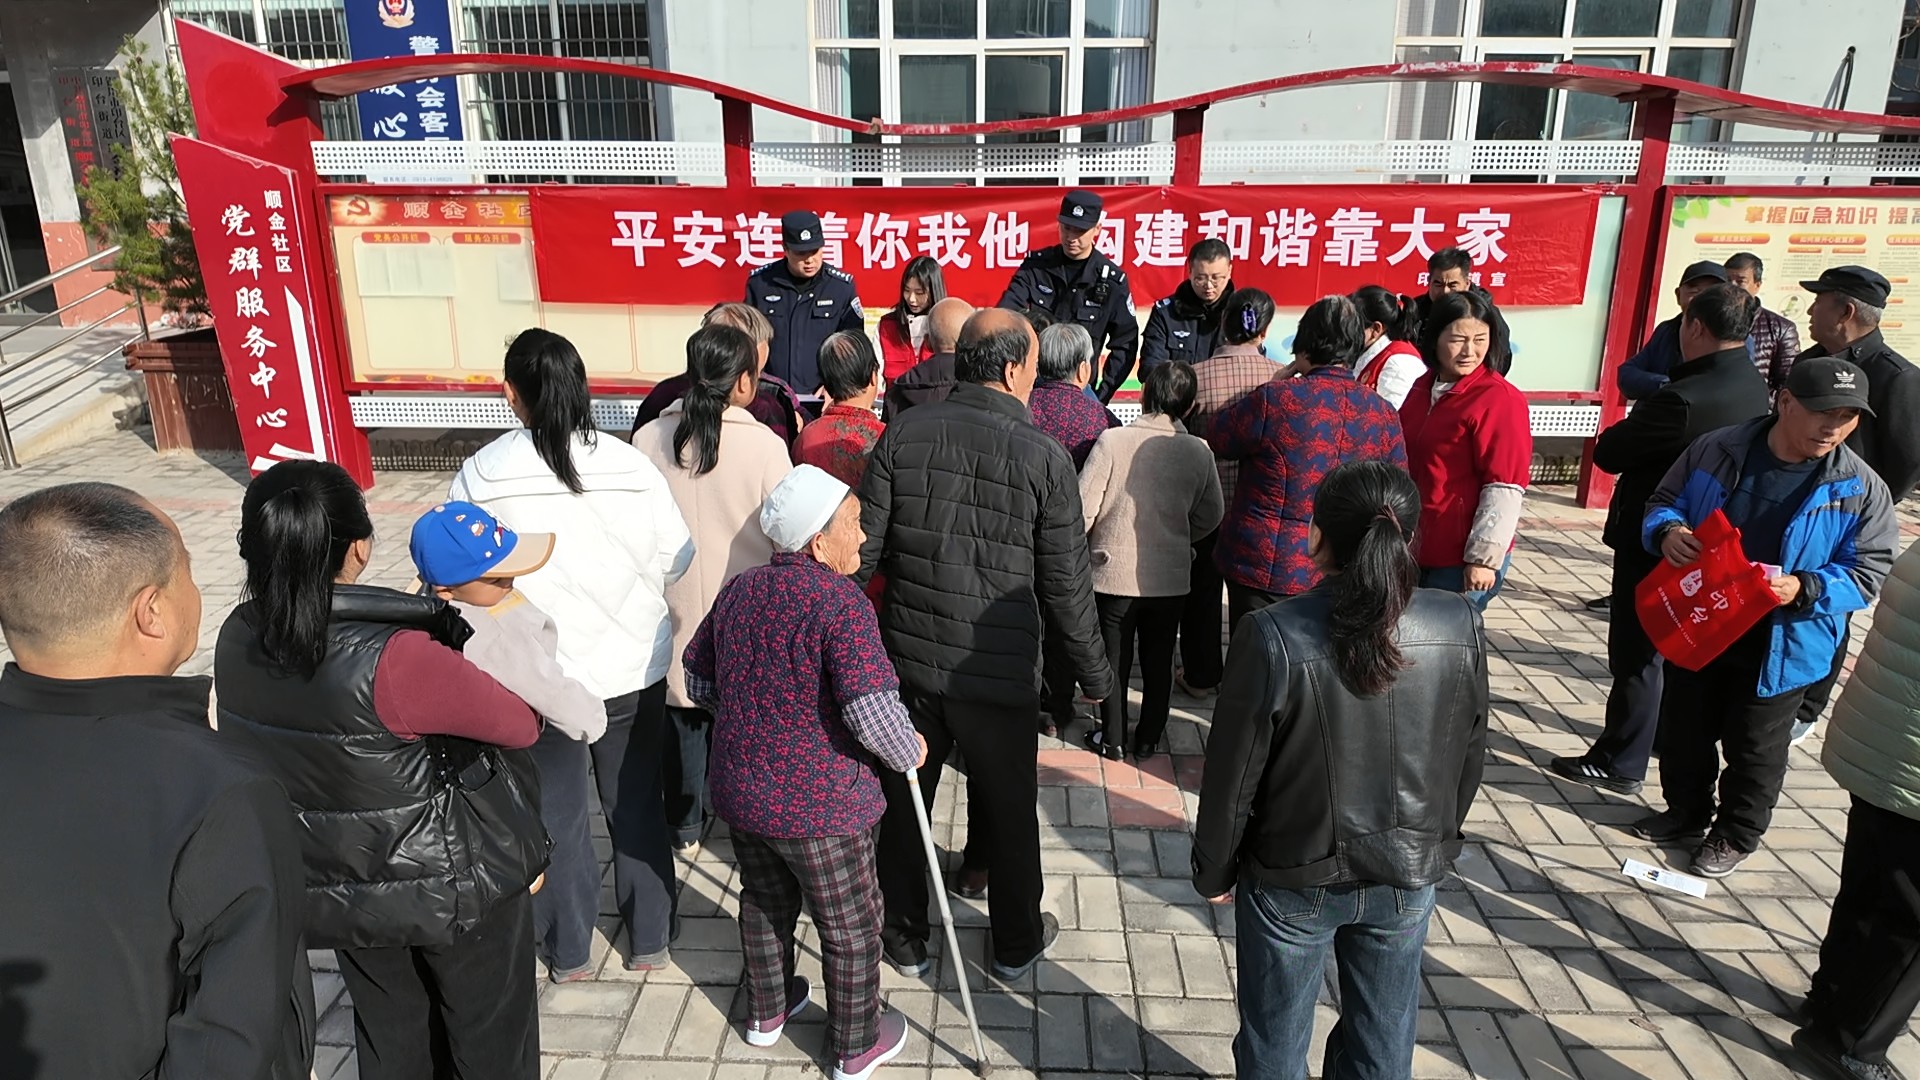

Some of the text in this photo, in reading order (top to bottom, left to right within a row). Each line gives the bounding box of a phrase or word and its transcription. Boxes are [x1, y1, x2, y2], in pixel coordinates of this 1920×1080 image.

[408, 35, 450, 142] 警会客
[264, 190, 292, 273] 顺金社区
[611, 209, 1031, 269] 平安连着你我他
[1091, 207, 1511, 268] 构建和谐靠大家
[1745, 206, 1878, 225] 掌握应急知识
[1417, 272, 1506, 287] 印道宣
[220, 204, 288, 429] 党群服务中心
